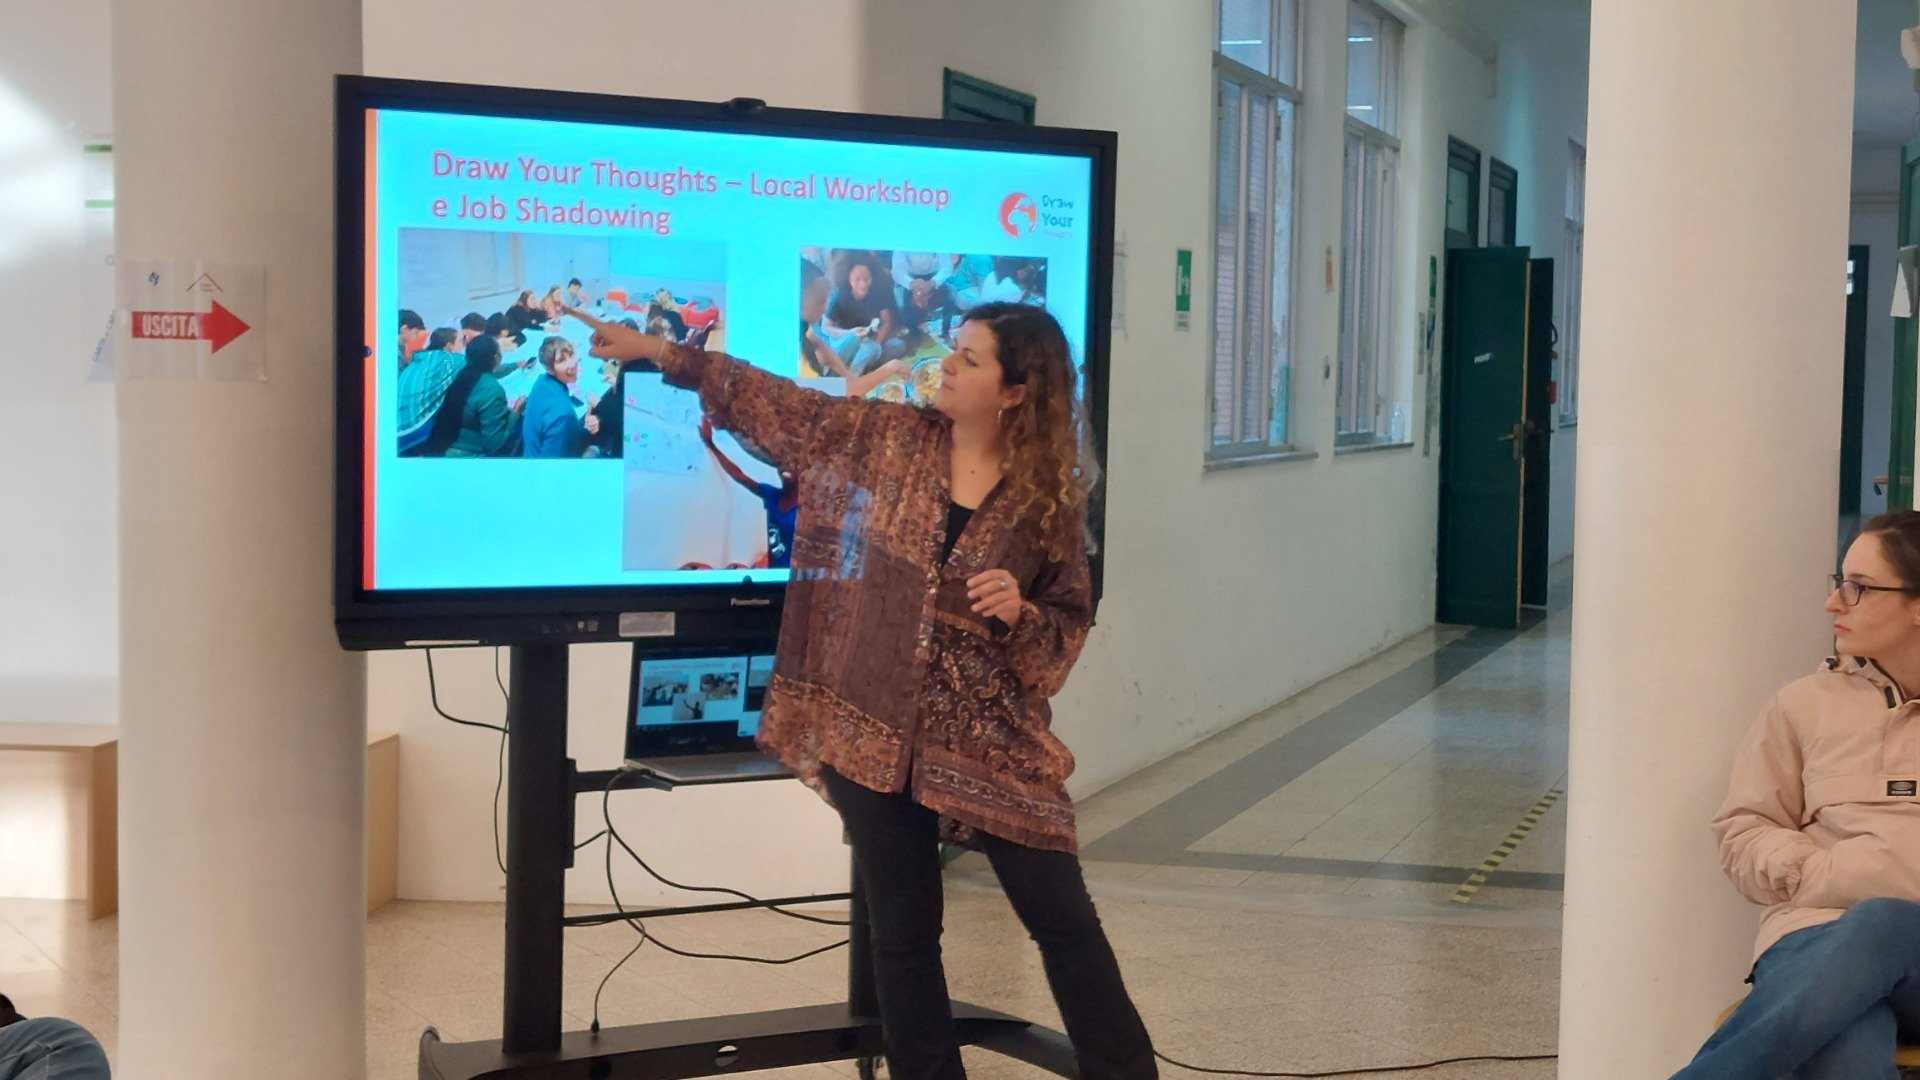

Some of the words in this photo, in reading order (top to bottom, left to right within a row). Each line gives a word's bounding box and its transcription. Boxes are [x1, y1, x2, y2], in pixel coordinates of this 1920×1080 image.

[432, 150, 509, 181] Draw
[517, 157, 582, 185] Your
[592, 160, 718, 197] Thoughts
[751, 172, 816, 199] Local
[824, 177, 951, 211] Workshop
[1042, 194, 1074, 209] Draw
[432, 198, 449, 219] e
[457, 195, 507, 221] Job
[515, 197, 672, 237] Shadowing
[1041, 212, 1074, 228] Your
[141, 314, 200, 337] USCITA
